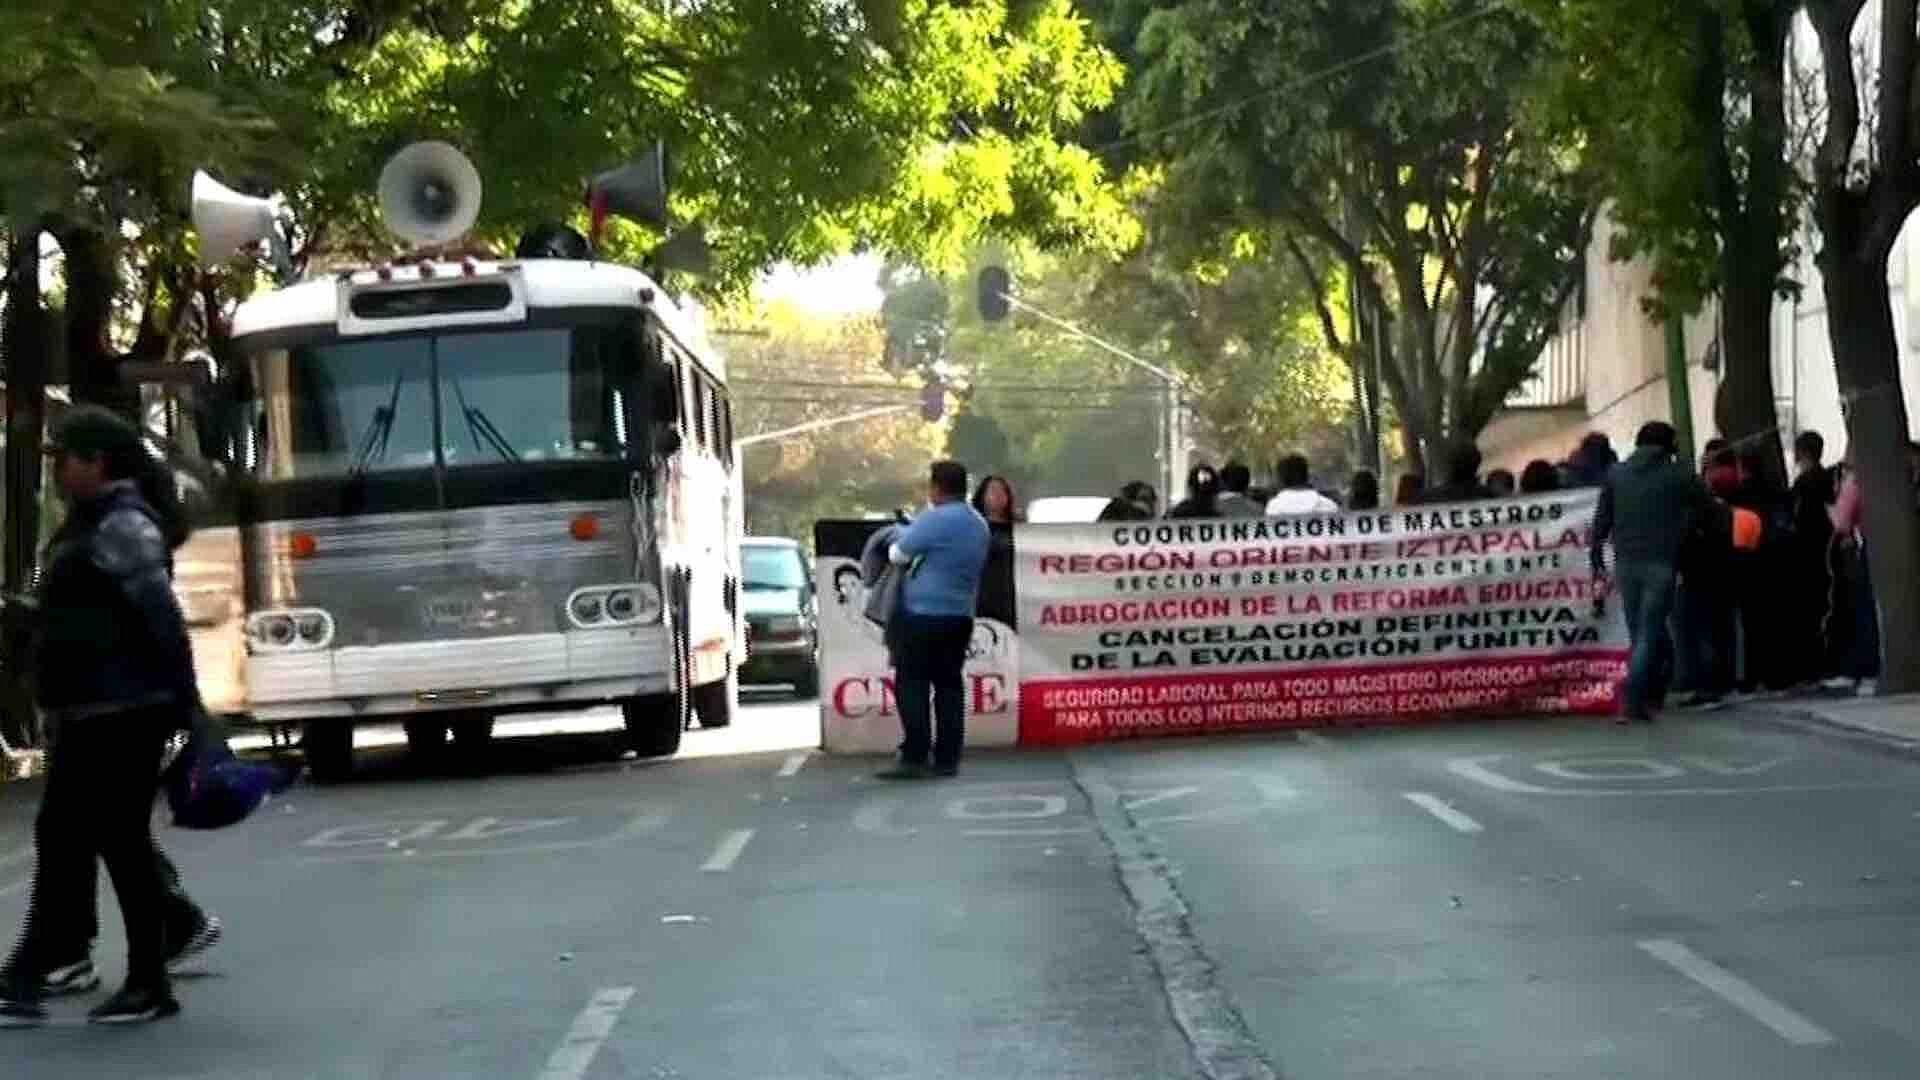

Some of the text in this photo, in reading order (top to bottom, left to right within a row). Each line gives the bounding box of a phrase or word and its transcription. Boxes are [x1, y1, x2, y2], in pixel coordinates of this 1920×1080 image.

[1356, 514, 1393, 535] DE
[1404, 503, 1563, 531] MAESTROS
[1039, 546, 1195, 574] REGIÓN
[1209, 541, 1378, 569] ORIENTE
[1041, 574, 1613, 625] ABROGACIÓN DE LA REFORMA EDUCAT
[1099, 606, 1575, 648] CANCELACIÓN DEFINITIVA
[1071, 627, 1599, 671] DE LA EVALUACIÓN PUNITIVA
[834, 672, 1009, 719] CE
[1043, 686, 1145, 709] SEGURIDAD
[1149, 682, 1227, 706] LABORAL
[1232, 681, 1278, 700] PARA
[1283, 676, 1329, 698] TODO
[1333, 668, 1438, 695] MAGISTERIO
[1055, 709, 1103, 728] PARA
[1107, 706, 1164, 727] TODOS
[1168, 705, 1205, 724] LOS
[1208, 699, 1297, 722] INTERINOS
[1301, 694, 1393, 719] RECURSOS
